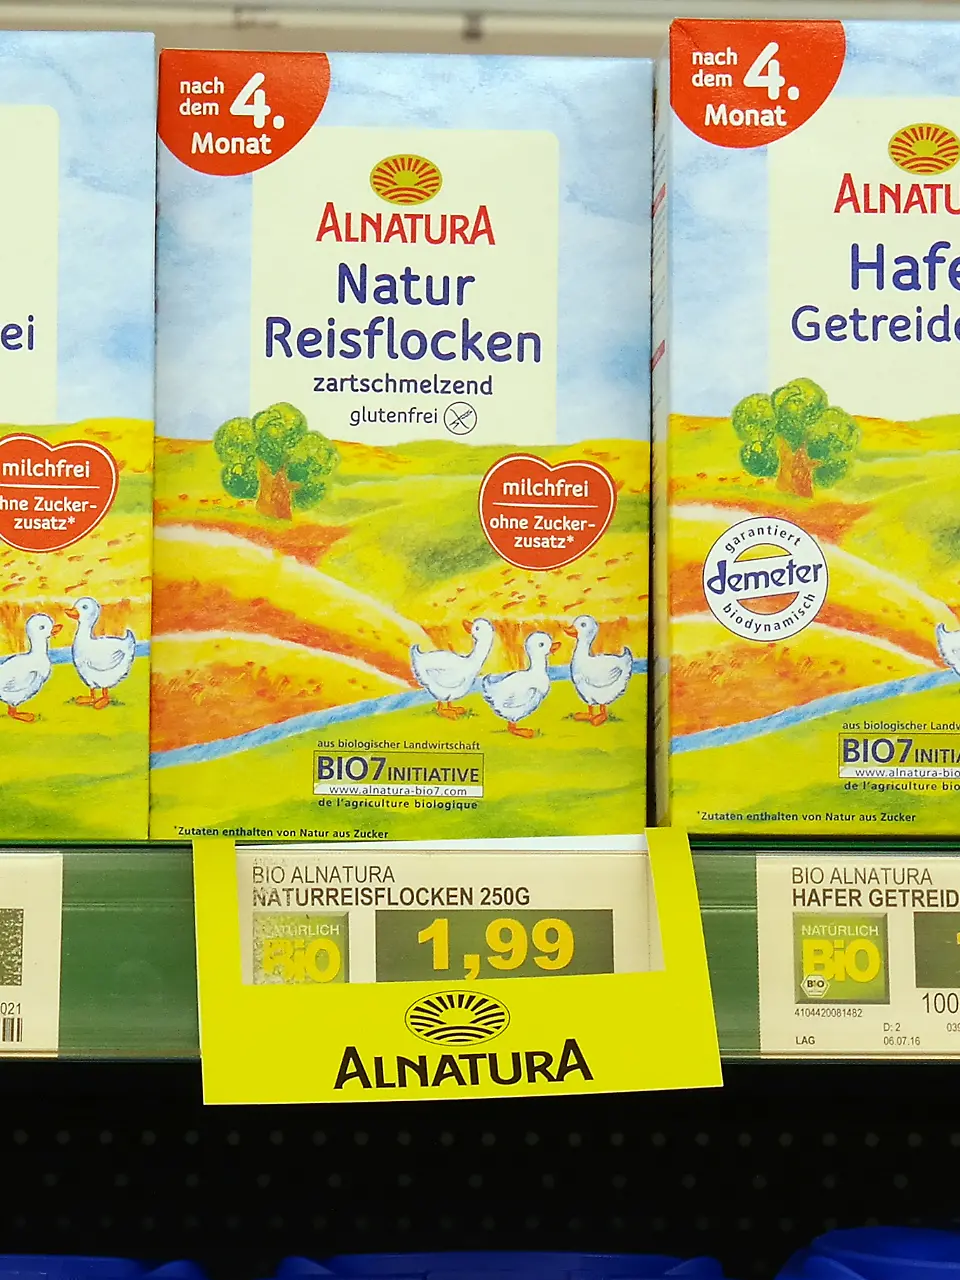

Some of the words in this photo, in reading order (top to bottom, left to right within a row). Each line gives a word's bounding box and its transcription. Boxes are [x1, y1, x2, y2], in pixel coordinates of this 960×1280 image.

[692, 46, 737, 66] nach
[691, 69, 732, 88] dem
[743, 42, 800, 101] 4.
[180, 77, 225, 95] nach
[179, 98, 219, 116] dem
[230, 73, 284, 129] 4.
[704, 102, 787, 127] Monat
[191, 132, 272, 155] Monat
[316, 202, 496, 245] ALNATURA
[338, 263, 474, 306] Natur
[265, 316, 542, 363] Reisflocken
[314, 375, 493, 397] zartschmelzend
[350, 406, 438, 428] glutenfrei
[503, 478, 588, 498] milchfrei
[490, 515, 529, 530] ohne
[534, 515, 596, 531] Zucker-
[725, 525, 801, 554] garantiert
[706, 559, 823, 595] demeter
[722, 593, 816, 634] biodynamisch
[842, 722, 860, 731] aus
[864, 721, 927, 732] biologischer
[844, 781, 858, 791] de
[747, 811, 798, 822] enthalten
[802, 812, 822, 822] von
[825, 811, 856, 822] Natur
[859, 813, 877, 822] aus
[880, 812, 916, 822] Zucker
[252, 866, 285, 883] BIO
[291, 866, 395, 883] ALNATURA
[792, 867, 825, 885] BIO
[830, 867, 932, 885] ALNATURA
[253, 887, 473, 906] NATURREISFLOCKEN
[480, 887, 530, 906] 250G
[792, 889, 863, 908] HAFER
[801, 923, 878, 937] NATÜRLICH
[418, 918, 575, 981] 1,99
[922, 993, 959, 1014] 100
[795, 1036, 815, 1045] LAG
[883, 1036, 920, 1046] 06.07.16
[333, 1038, 593, 1090] ALNATURA
